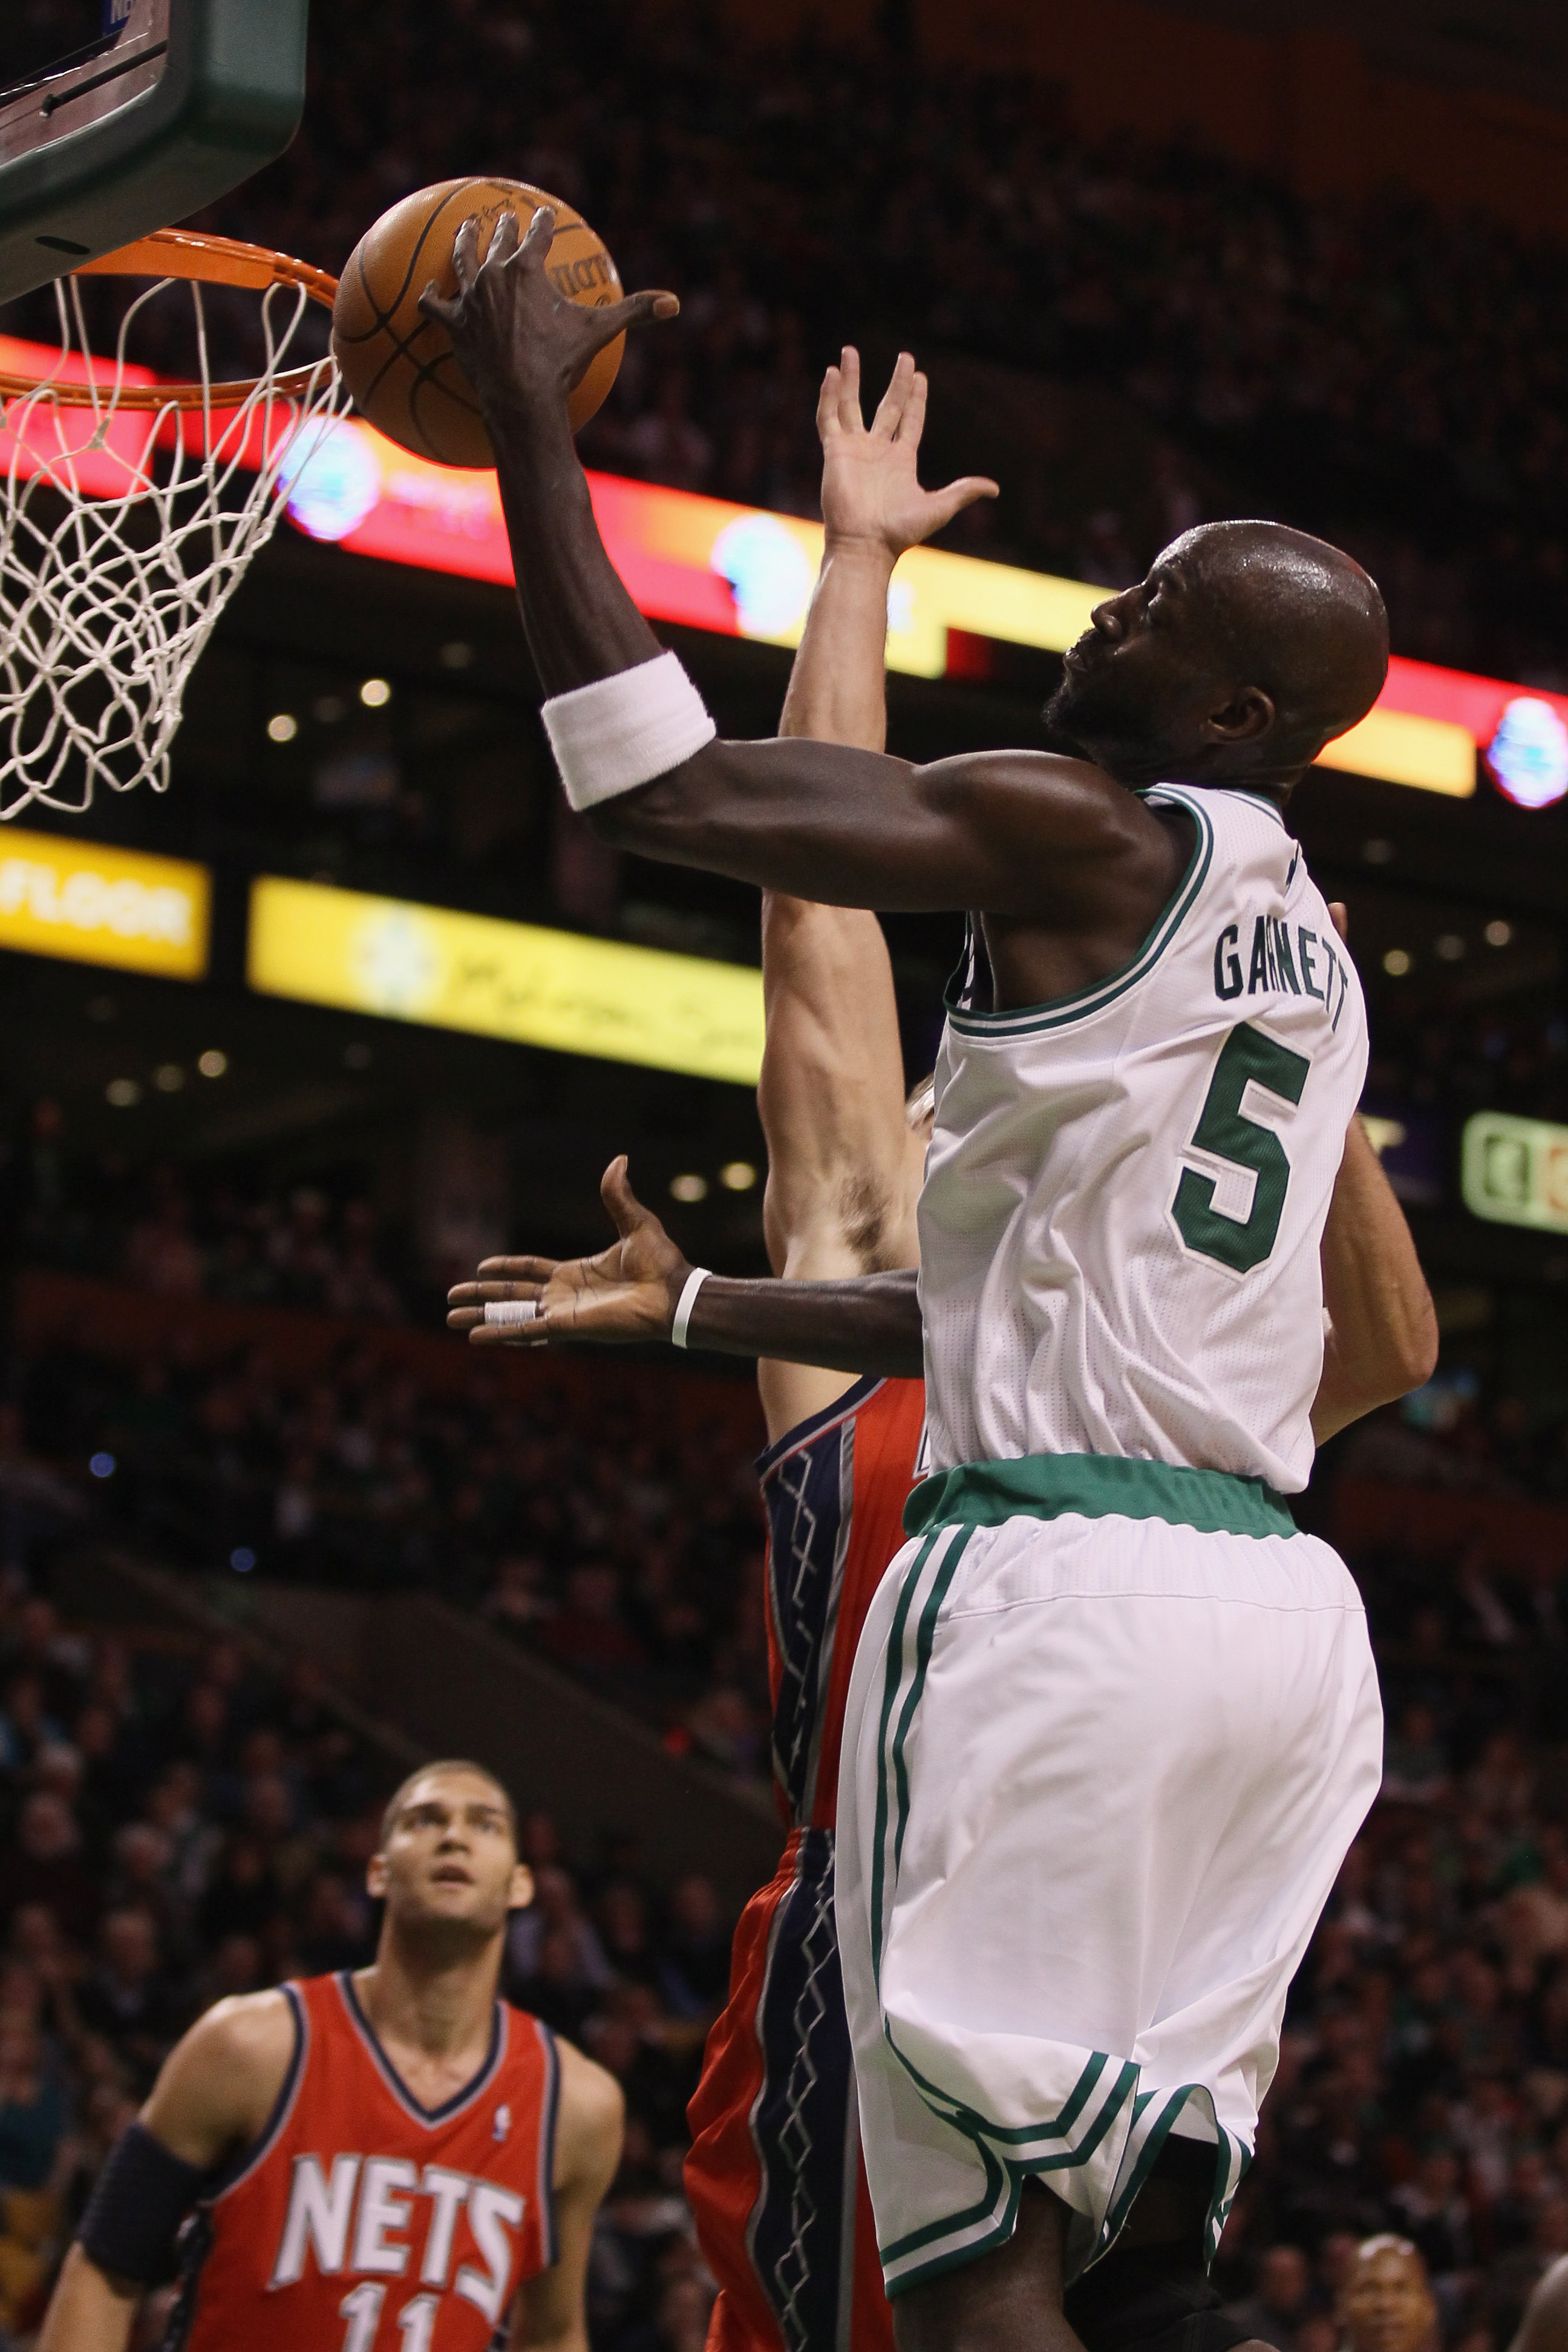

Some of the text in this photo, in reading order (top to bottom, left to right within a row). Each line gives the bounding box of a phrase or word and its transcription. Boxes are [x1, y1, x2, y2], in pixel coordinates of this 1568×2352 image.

[1170, 1021, 1312, 1275] 5
[266, 2152, 526, 2327] NETS
[339, 2280, 442, 2352] 11
